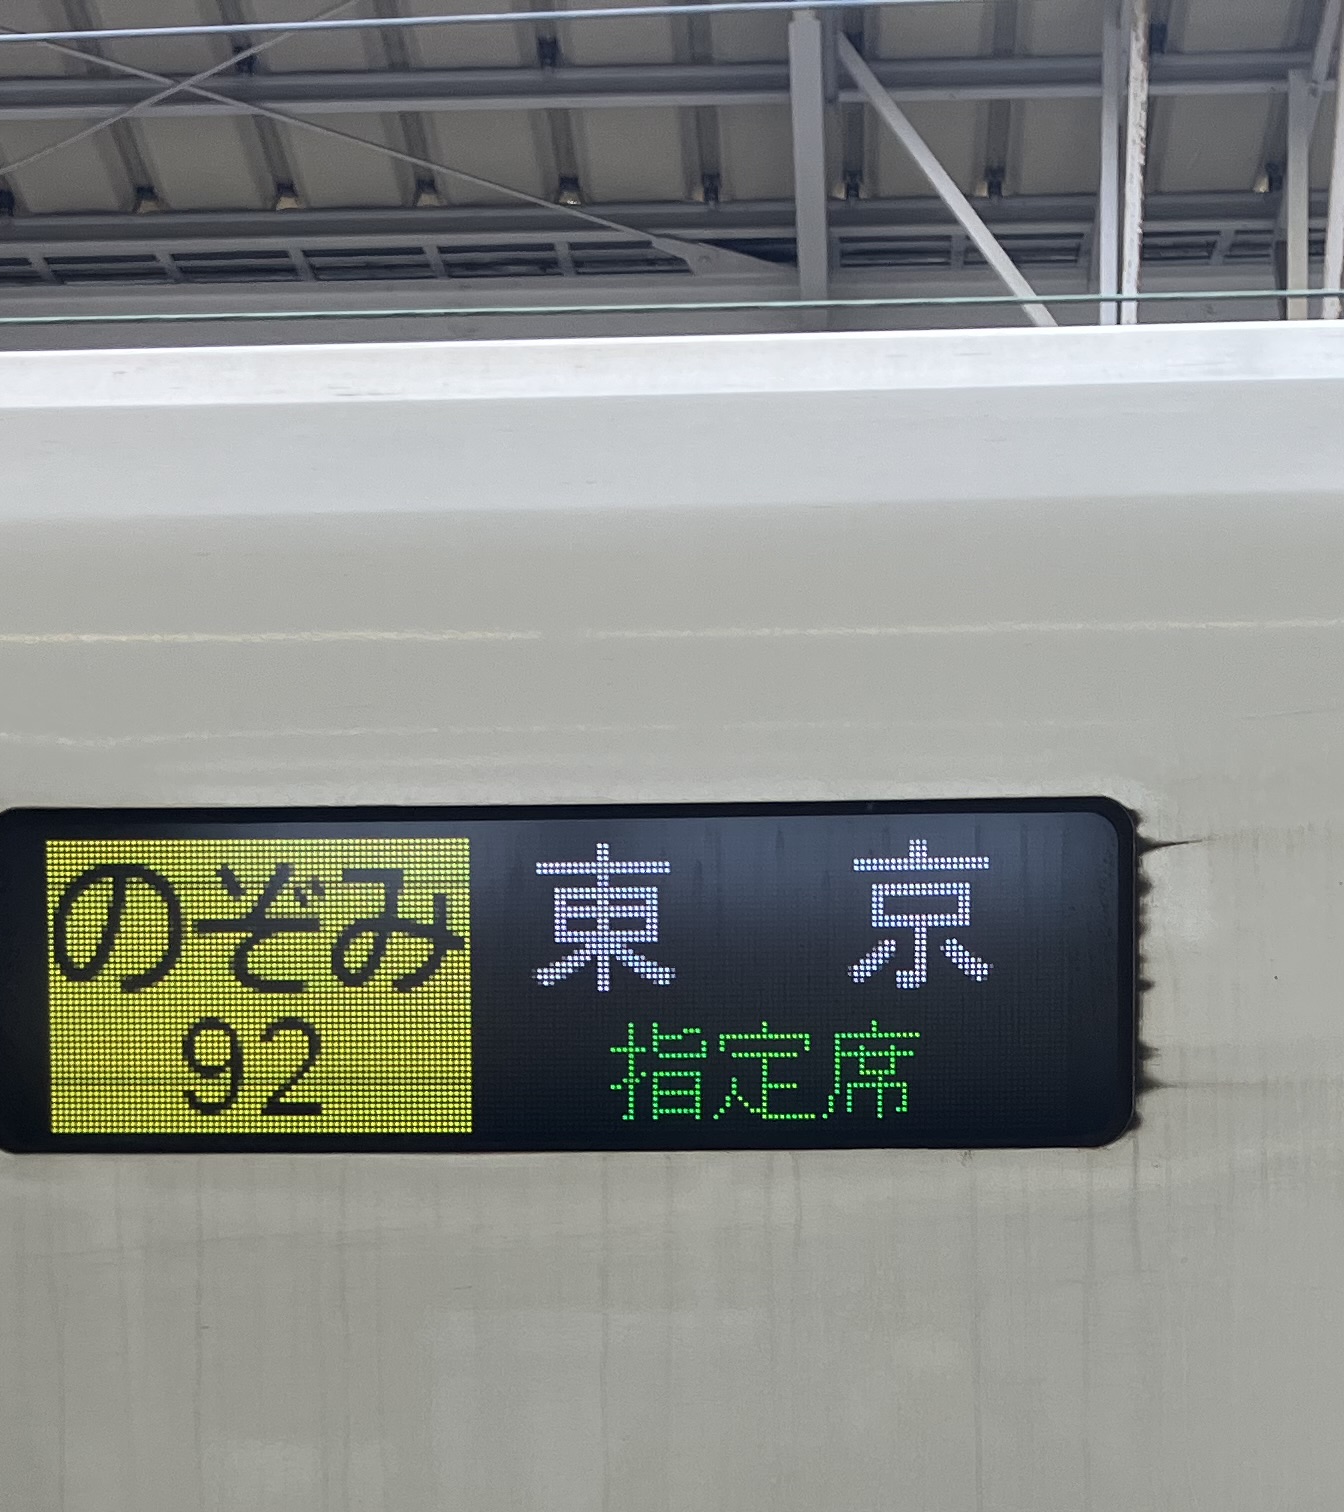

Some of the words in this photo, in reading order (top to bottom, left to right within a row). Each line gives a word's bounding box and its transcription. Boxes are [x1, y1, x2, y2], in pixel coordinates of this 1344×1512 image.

[50, 860, 466, 994] のぞみ
[180, 1015, 324, 1118] 92
[608, 1018, 922, 1122] 指定席
